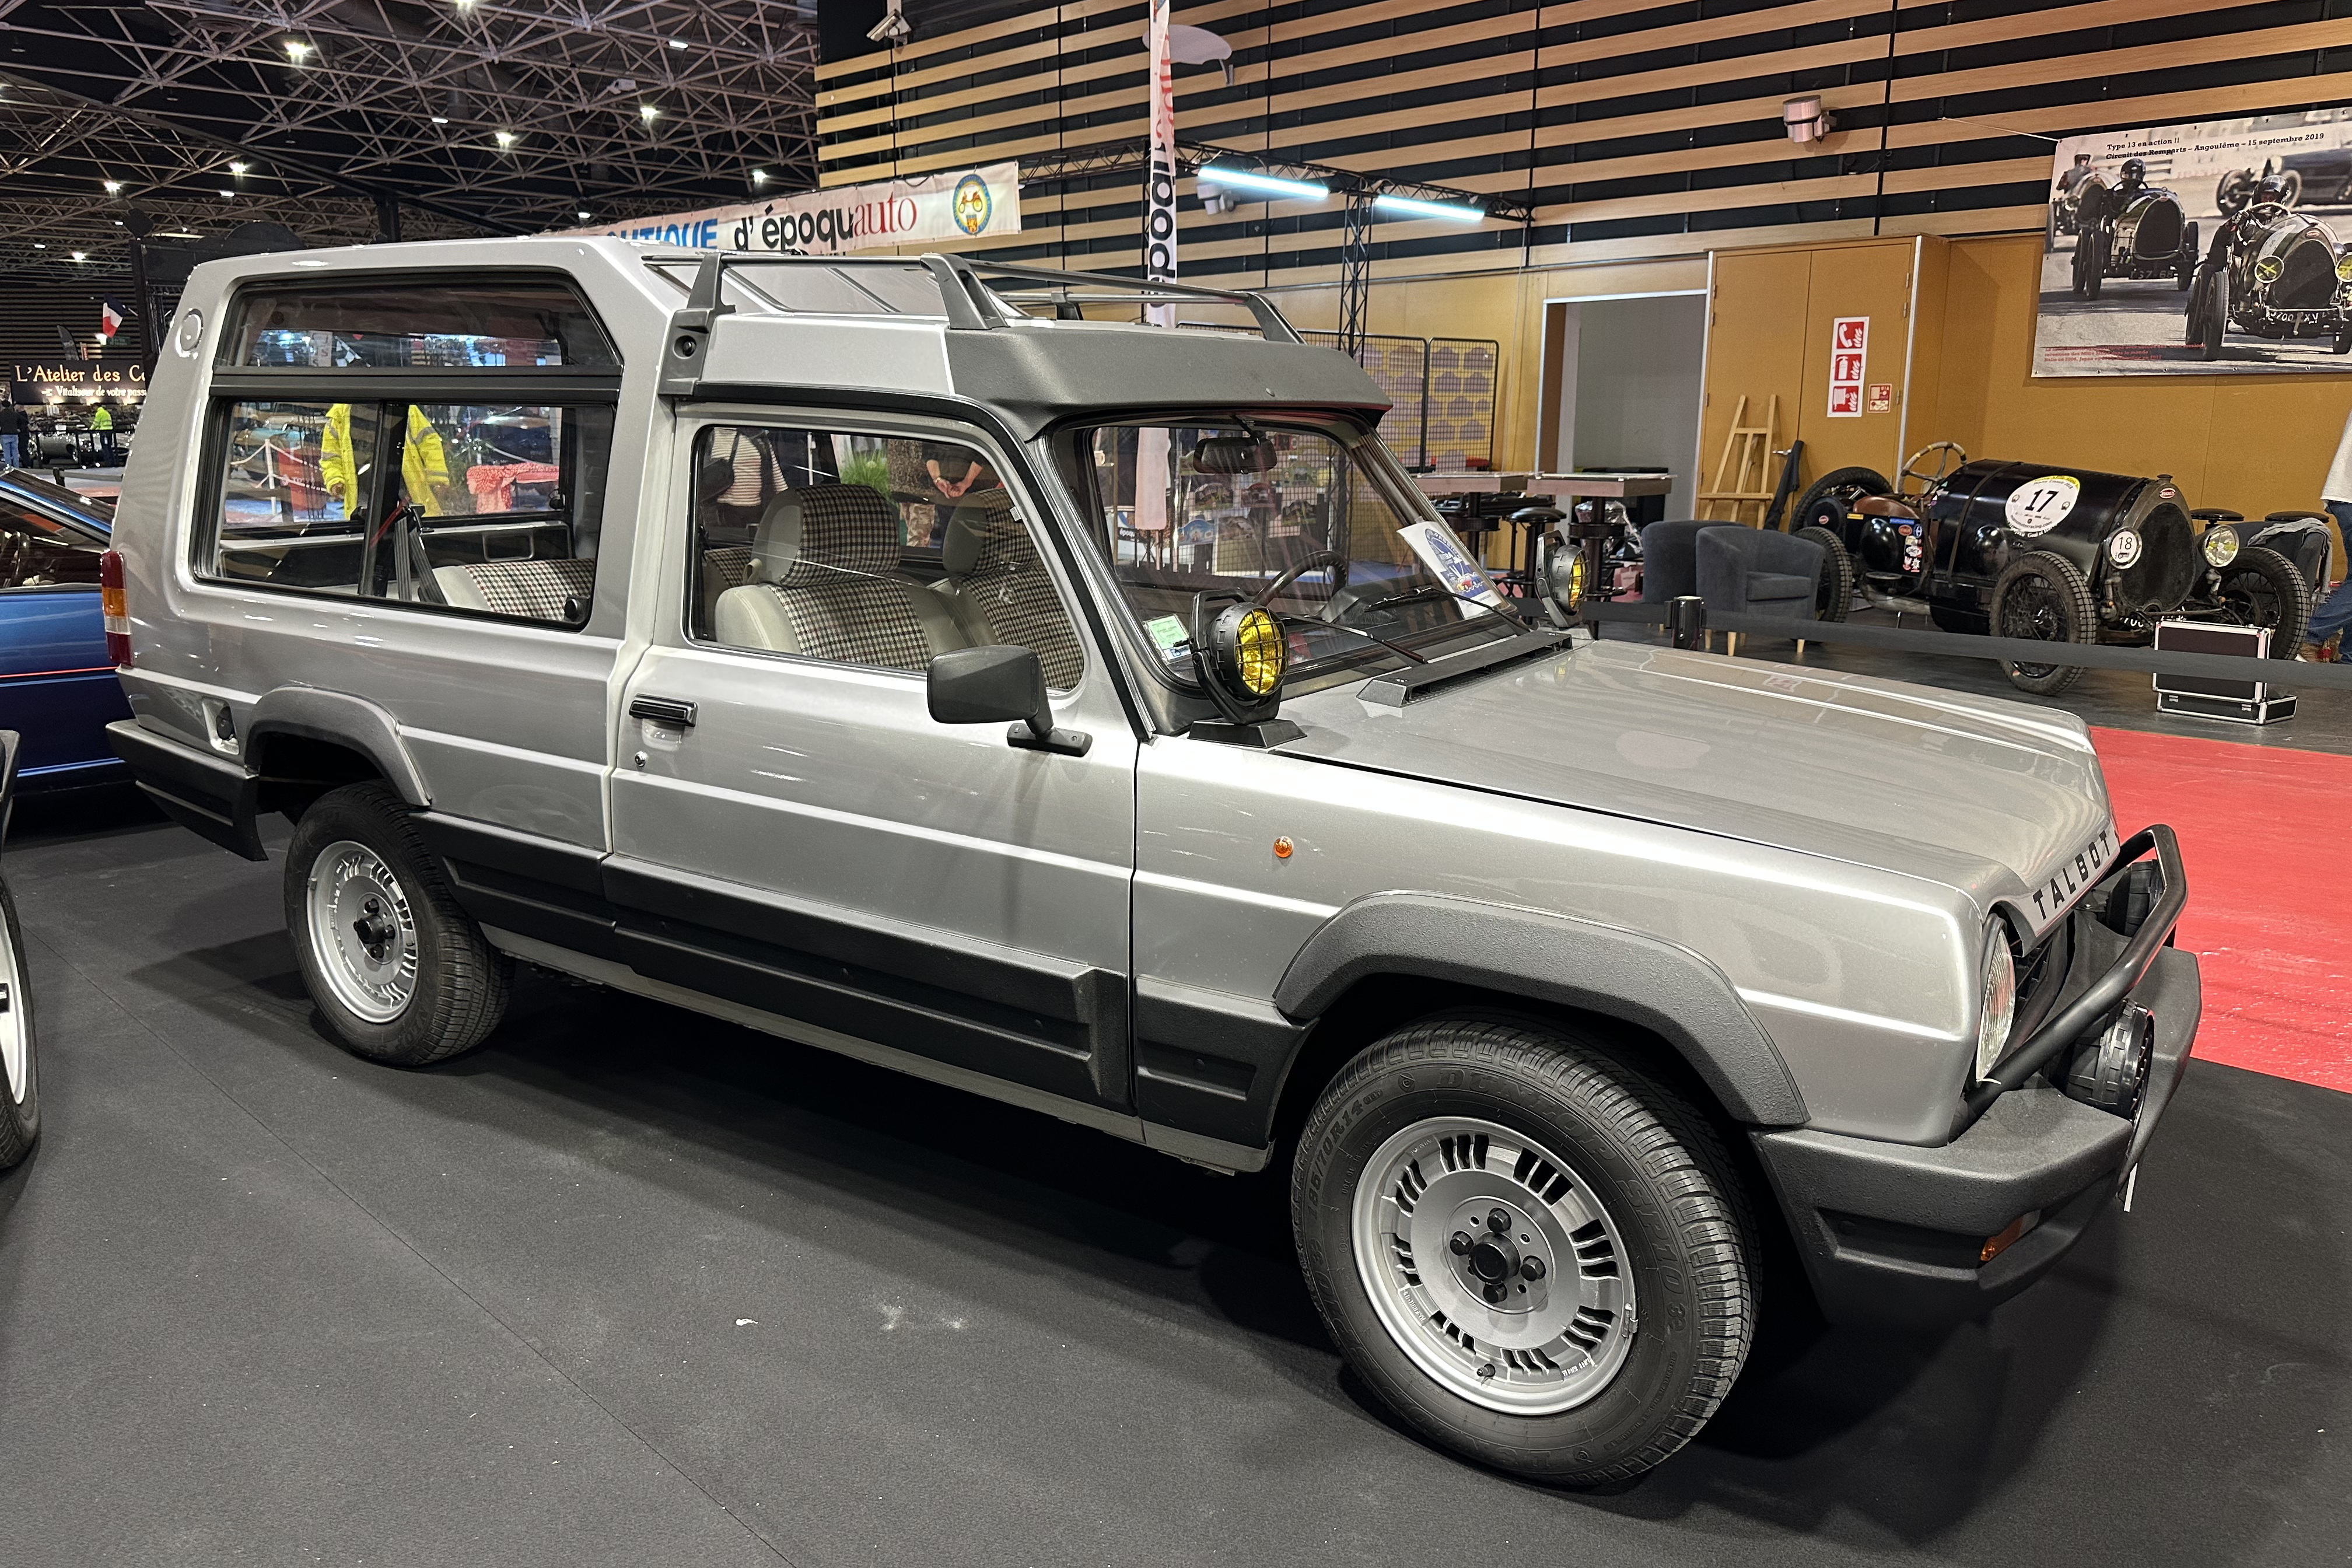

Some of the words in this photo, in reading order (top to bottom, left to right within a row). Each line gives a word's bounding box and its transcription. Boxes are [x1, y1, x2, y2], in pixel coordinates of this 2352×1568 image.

[2148, 147, 2186, 156] Remparts
[2194, 142, 2239, 152] Angoulême
[2259, 135, 2303, 145] septembre
[2305, 132, 2325, 141] 2019
[15, 364, 85, 383] L'Atelier
[93, 364, 120, 383] des
[96, 385, 105, 397] de
[2025, 489, 2059, 512] 17
[2119, 537, 2133, 550] 18
[2032, 830, 2110, 921] TALBOT
[1435, 1068, 1618, 1164] DUNLOP
[1306, 1098, 1364, 1221] 185/70R14
